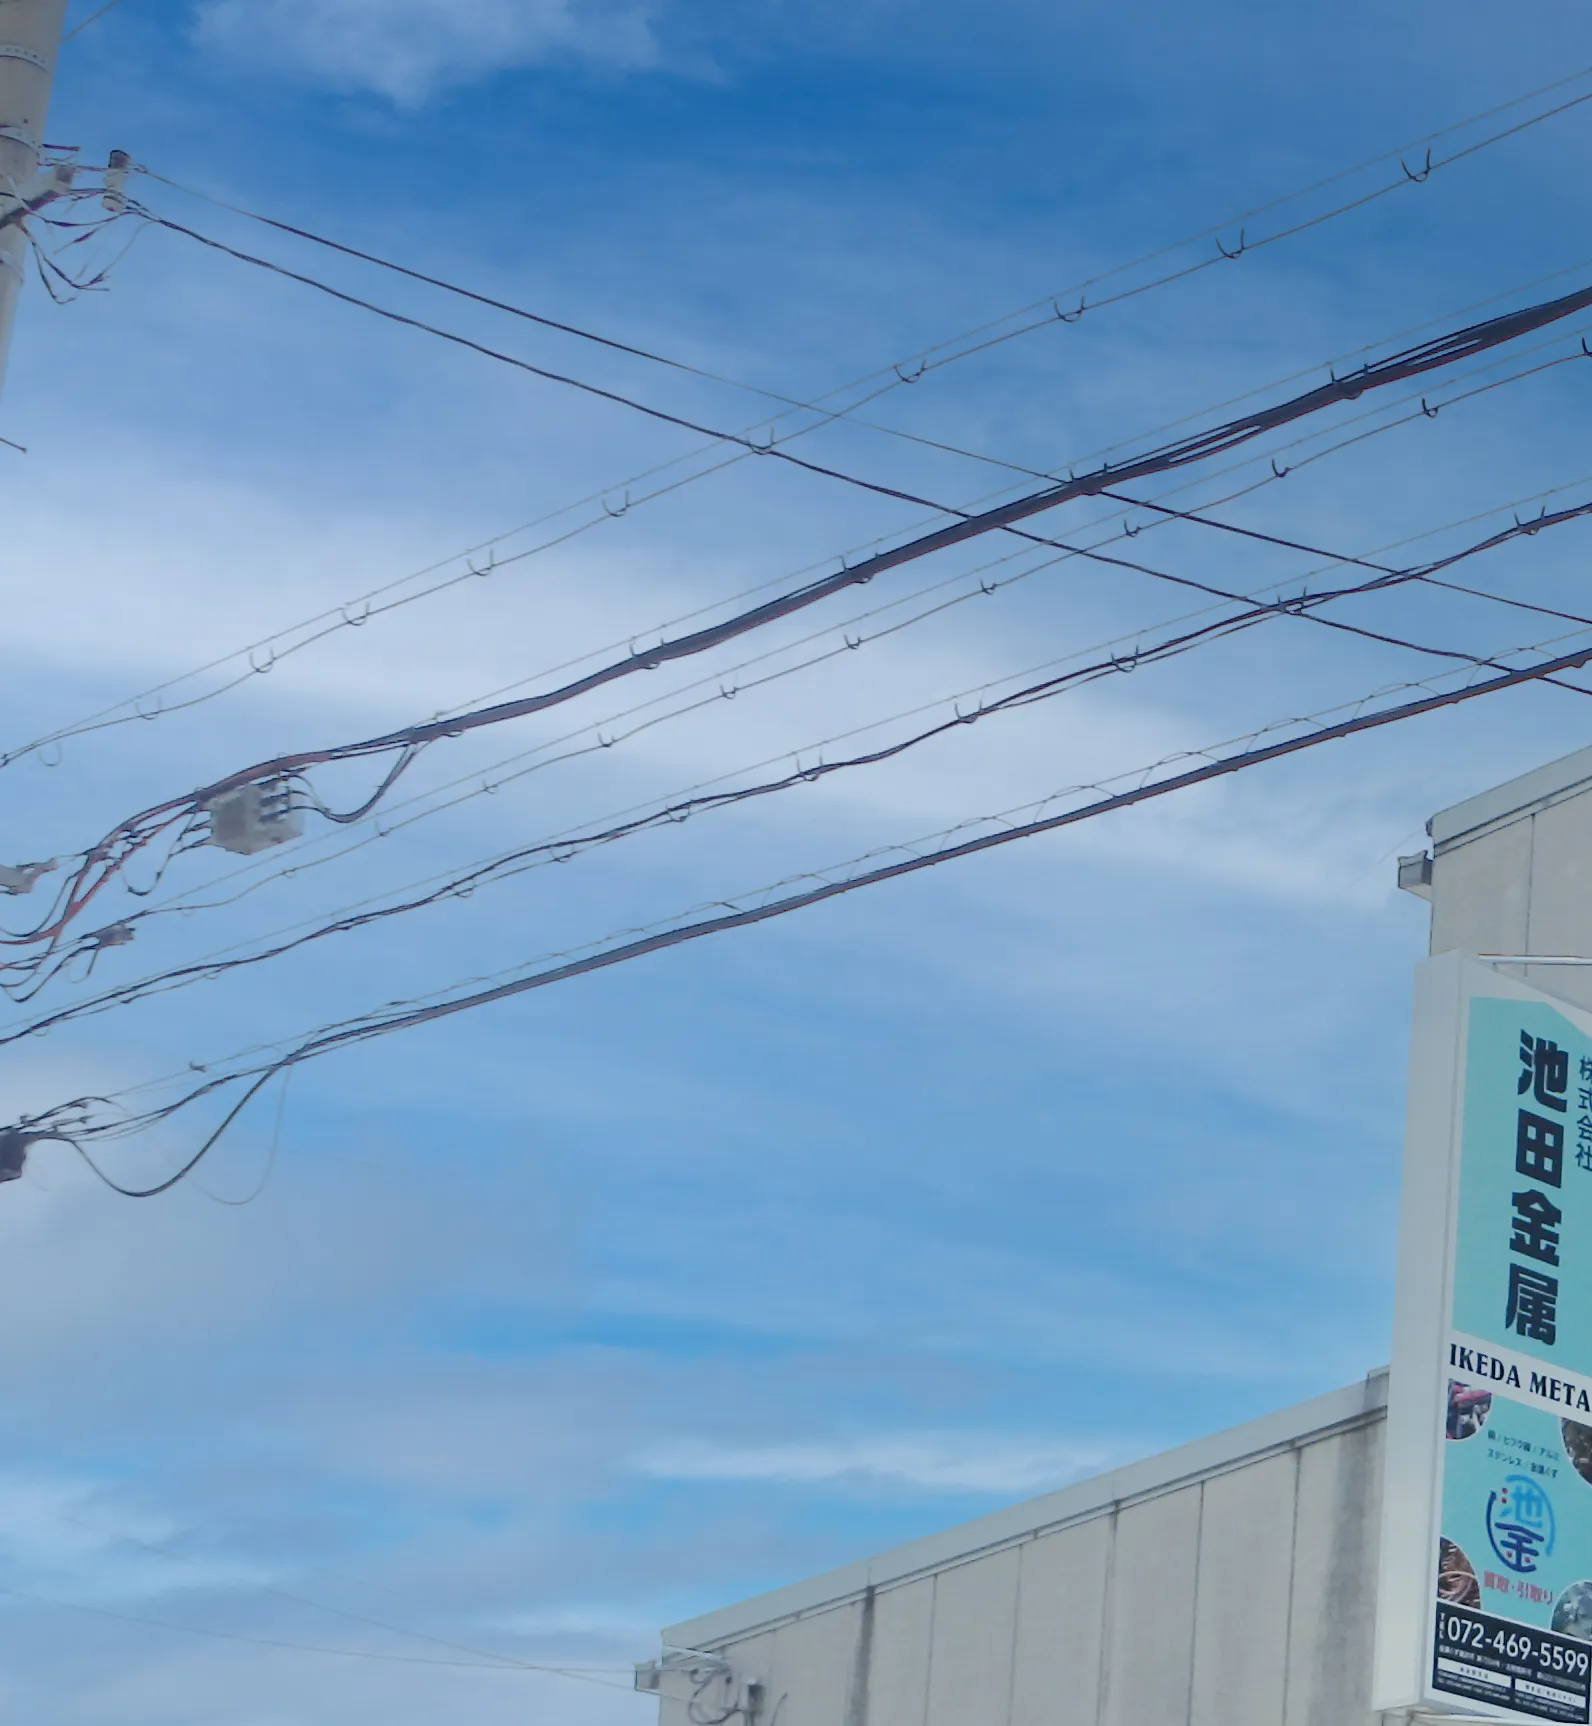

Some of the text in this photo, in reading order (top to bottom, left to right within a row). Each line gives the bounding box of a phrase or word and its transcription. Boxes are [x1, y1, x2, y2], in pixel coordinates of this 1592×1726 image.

[1505, 1028, 1569, 1346] 池田金属
[1450, 1343, 1521, 1389] IKEDA
[1447, 1616, 1589, 1677] 072-469-5599
